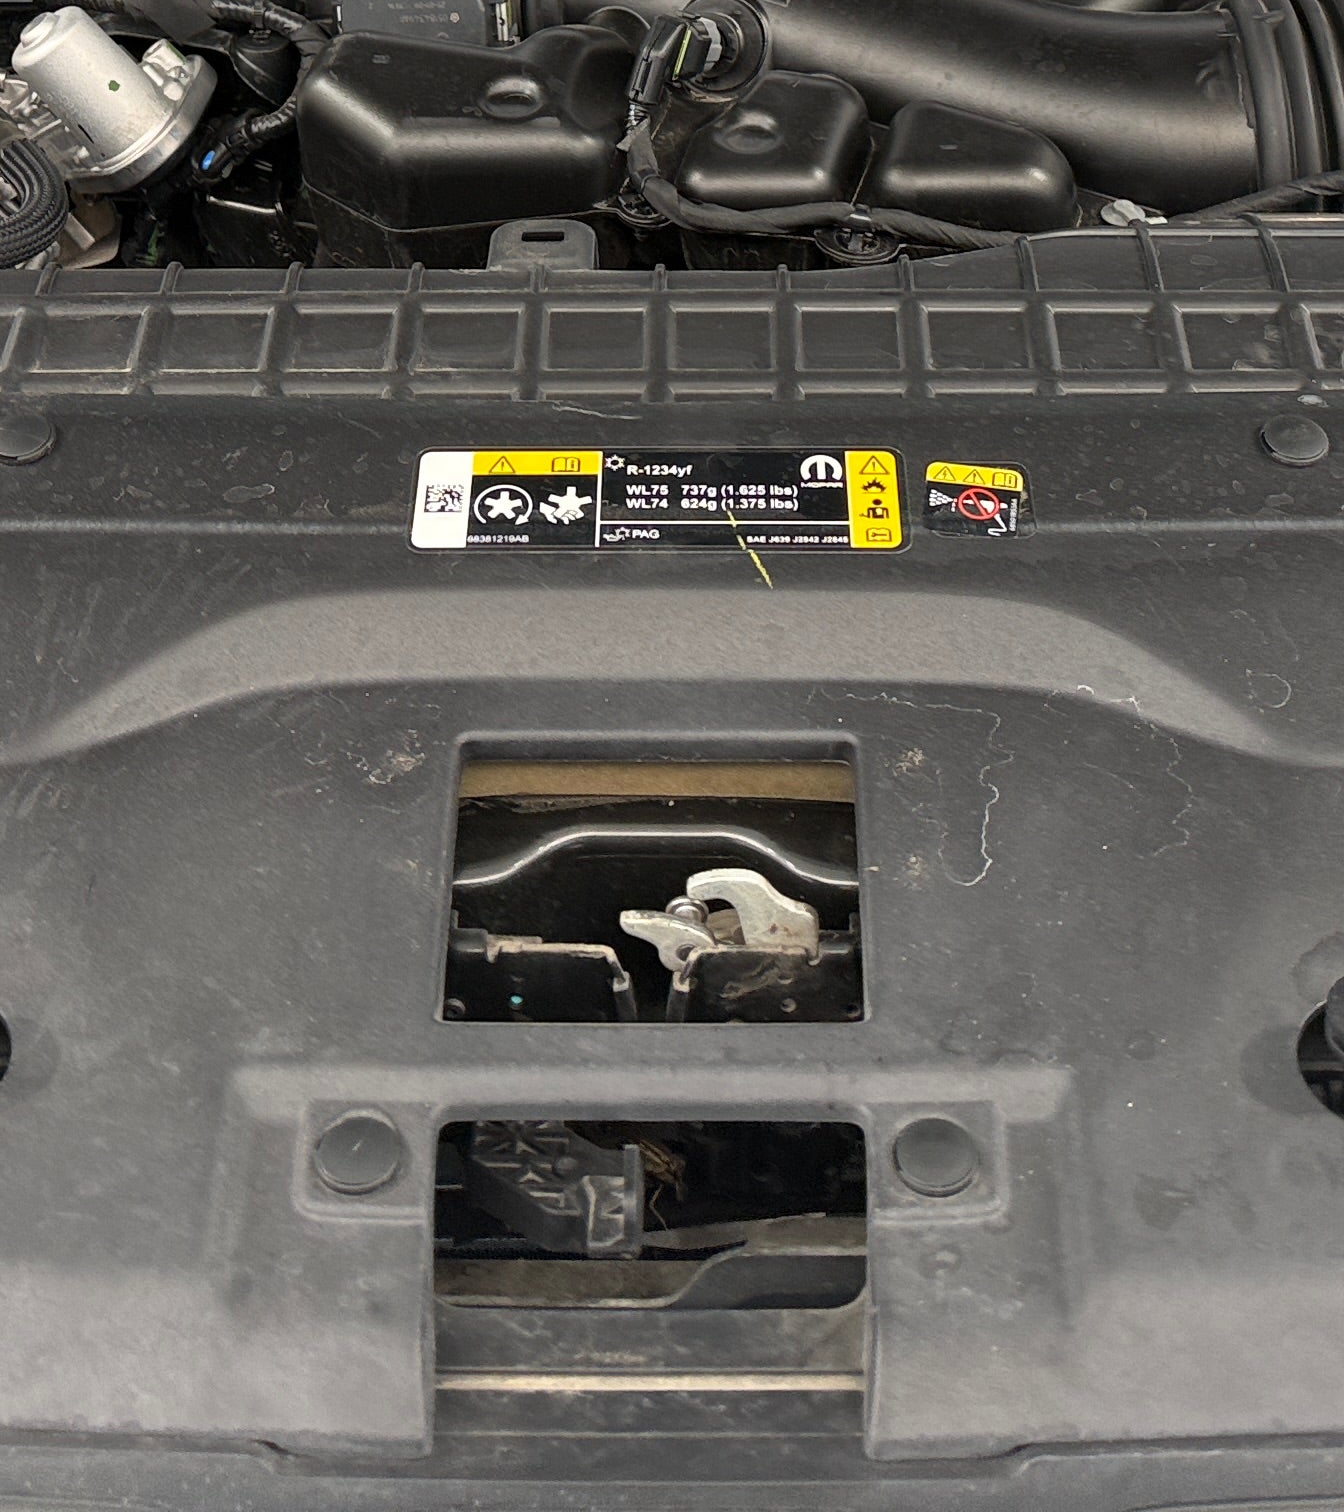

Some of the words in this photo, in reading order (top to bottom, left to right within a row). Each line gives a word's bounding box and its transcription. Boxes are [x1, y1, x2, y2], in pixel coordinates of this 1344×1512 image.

[626, 464, 693, 477] R-1234yf
[626, 484, 669, 496] WL75
[681, 484, 717, 498] 737g
[720, 484, 766, 498] (1.625
[769, 484, 799, 498] lbs)
[626, 498, 669, 509] WL74
[680, 498, 717, 511] 624g
[720, 498, 767, 510] (1.375
[769, 498, 799, 511] lbs)
[632, 529, 660, 539] PAG
[746, 535, 767, 544] SAE
